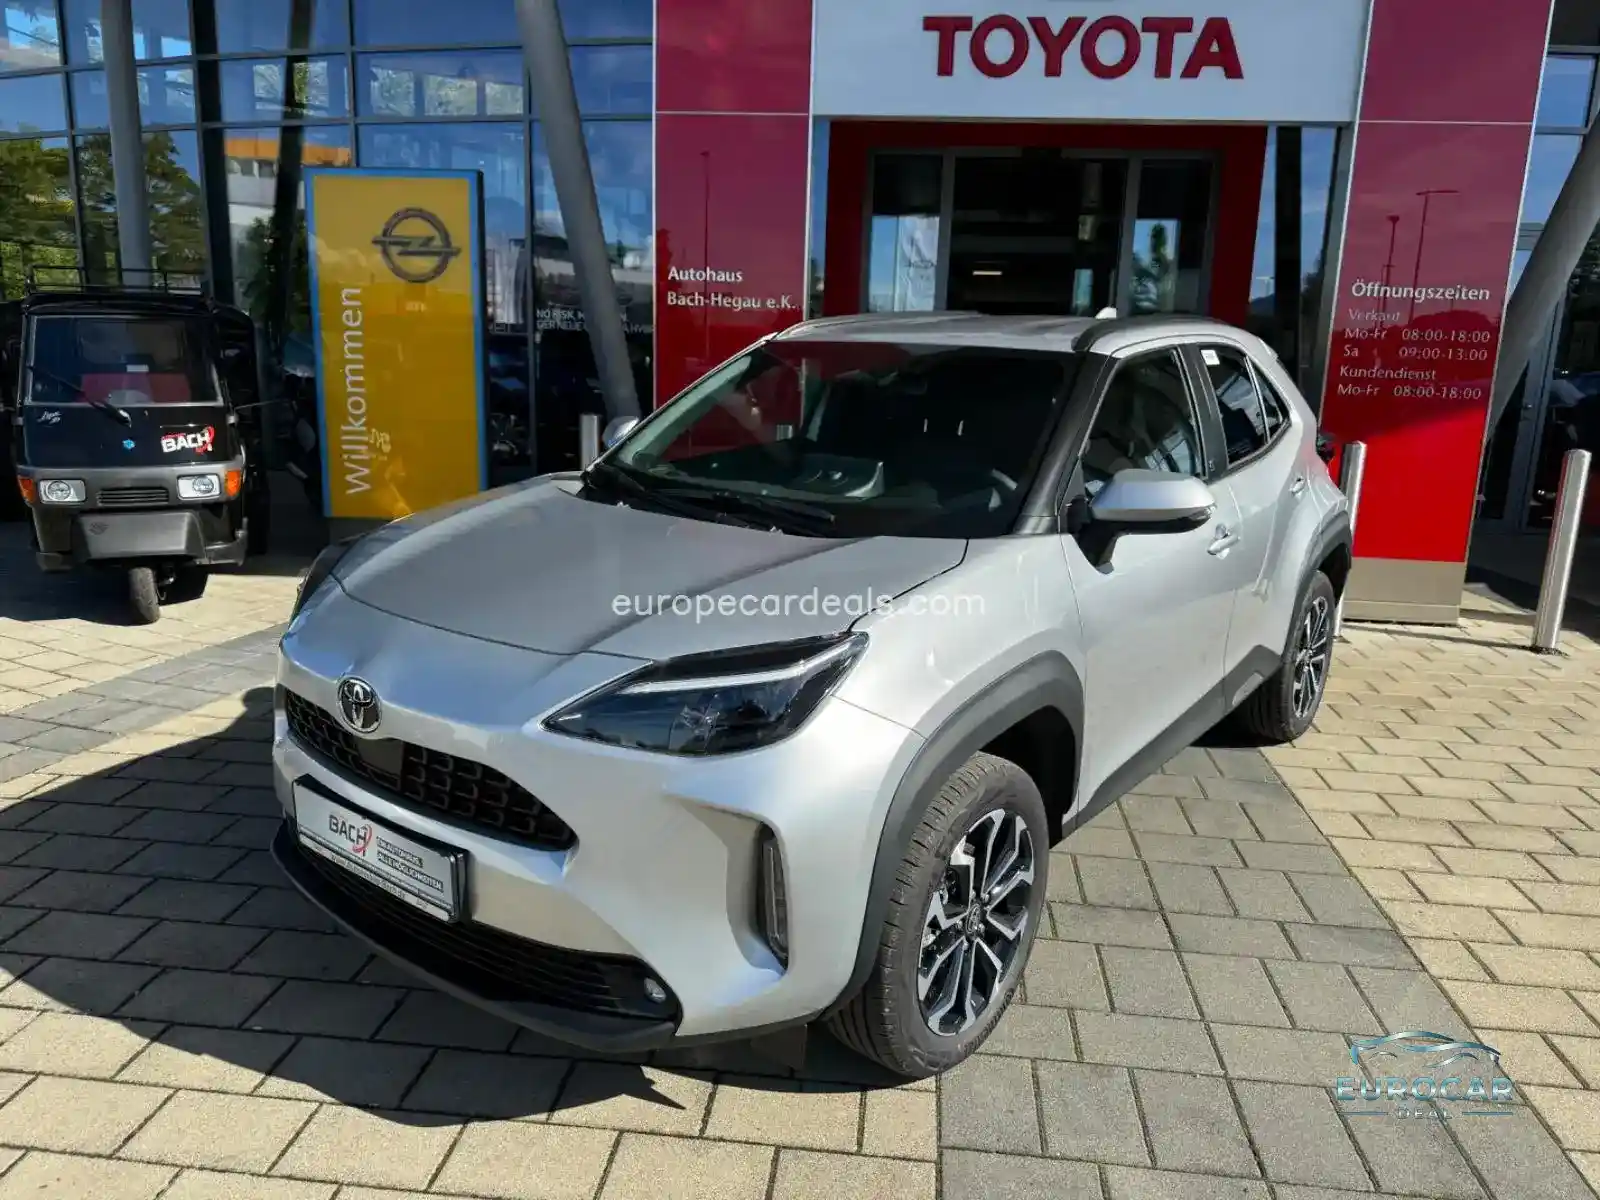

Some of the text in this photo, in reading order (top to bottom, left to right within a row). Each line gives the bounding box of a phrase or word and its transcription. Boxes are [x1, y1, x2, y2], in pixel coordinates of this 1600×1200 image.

[922, 14, 1244, 80] TOYOTA
[667, 266, 743, 282] Autohaus
[1351, 278, 1490, 303] Öffnungszeiten
[667, 291, 797, 312] Bach-Hegau e.K.
[1344, 328, 1490, 343] Mo-Fr 08:00-18:00
[1343, 344, 1488, 361] Sa 09:00-13:00
[1340, 365, 1437, 380] Kundendienst
[340, 287, 372, 495] Willkommen
[1337, 384, 1482, 400] Mo-Fr 08:00-18:00
[160, 428, 213, 453] BACH
[328, 814, 369, 856] BACH
